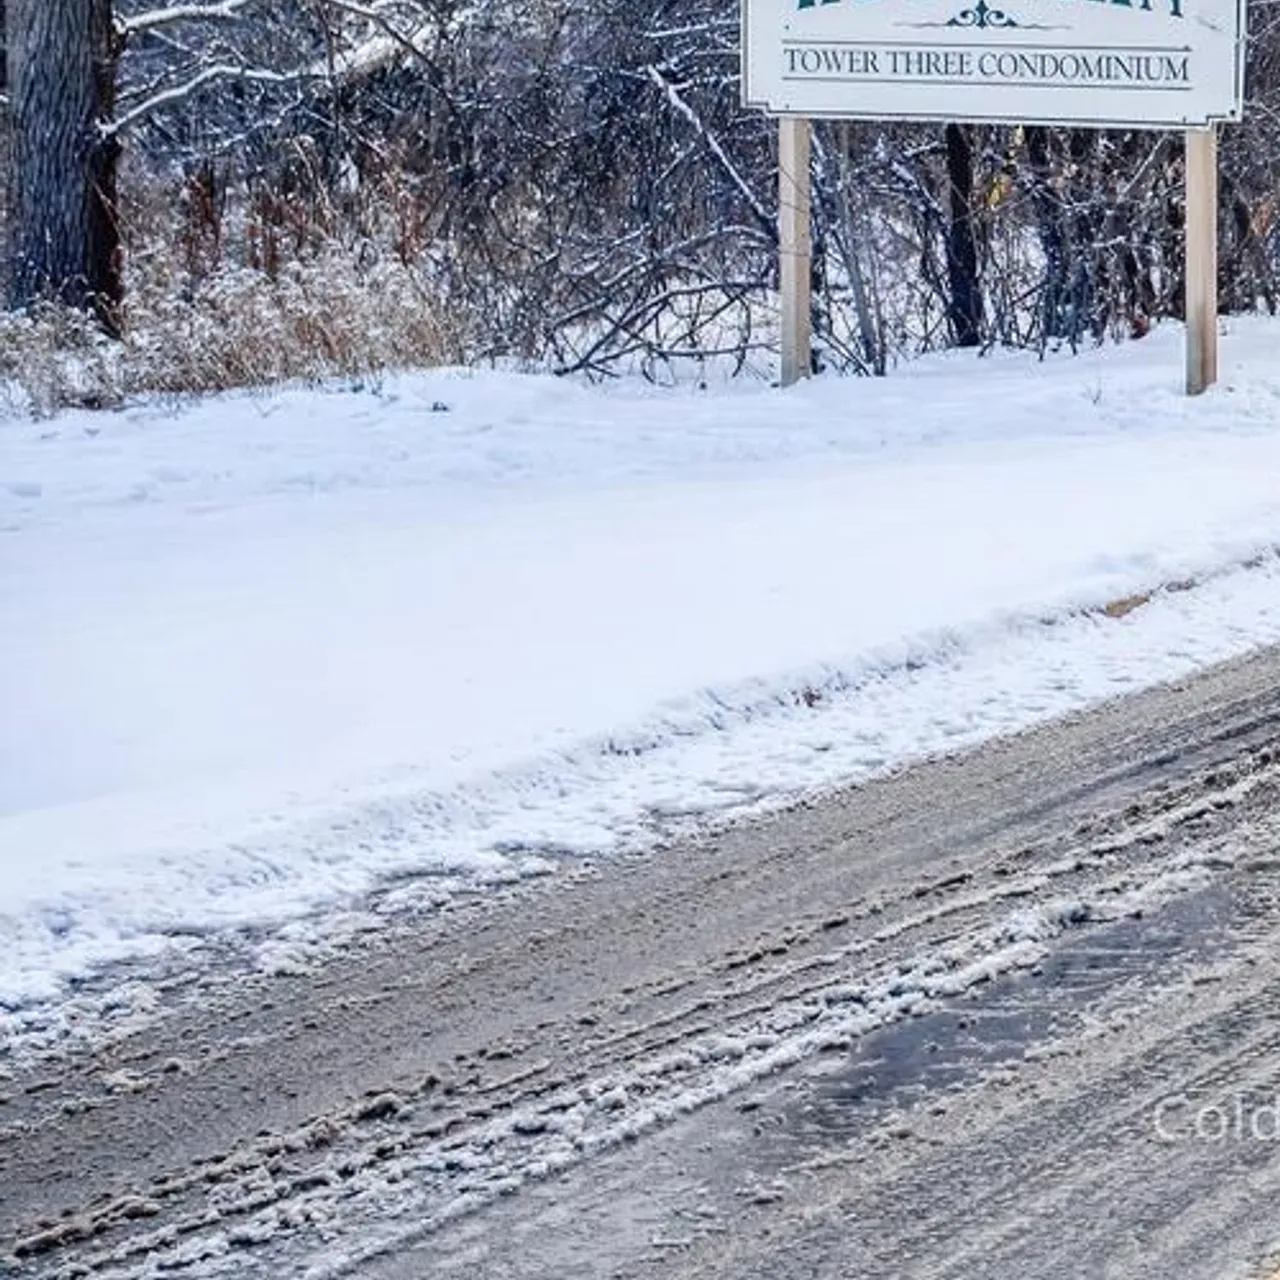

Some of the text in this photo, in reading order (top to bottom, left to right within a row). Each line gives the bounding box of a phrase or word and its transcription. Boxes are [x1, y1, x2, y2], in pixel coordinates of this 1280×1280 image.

[783, 48, 1190, 82] TOWER THREE CONDOMINIUM
